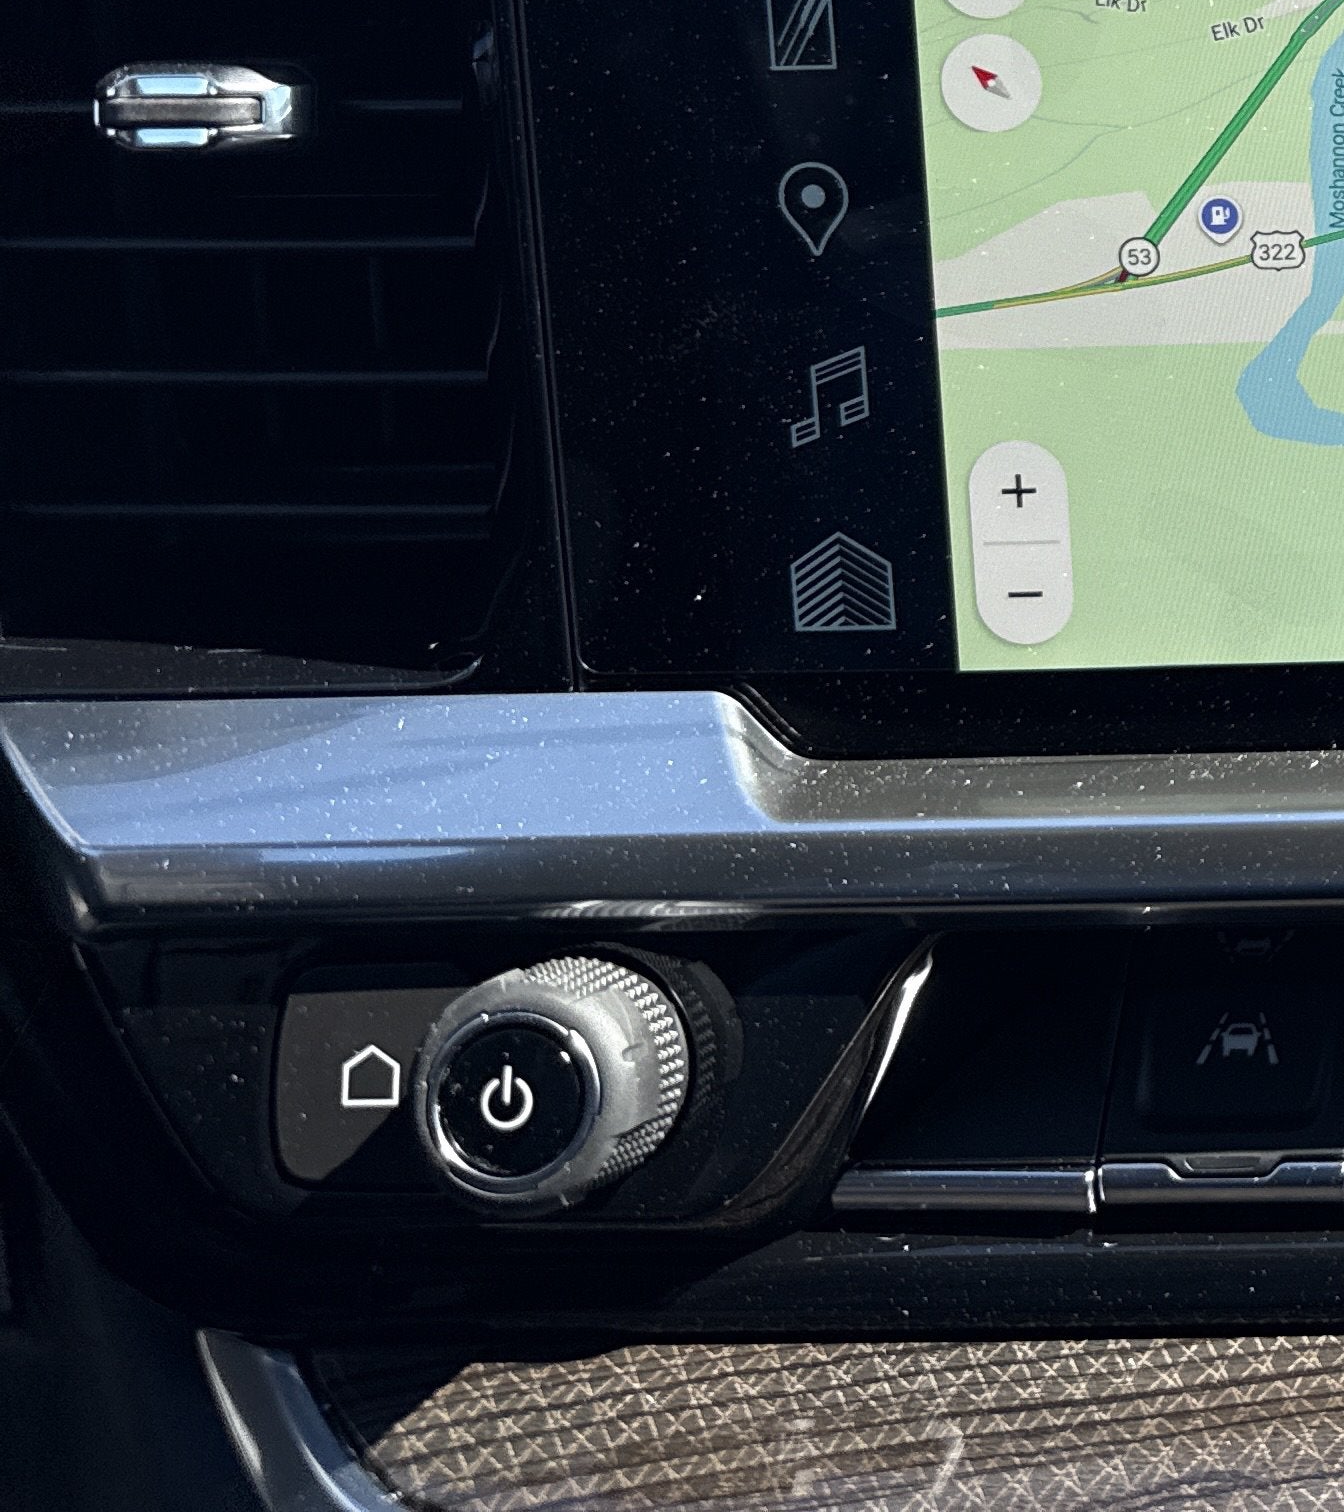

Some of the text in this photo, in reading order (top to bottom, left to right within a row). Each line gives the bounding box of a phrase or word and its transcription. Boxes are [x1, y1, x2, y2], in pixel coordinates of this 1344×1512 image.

[1210, 15, 1265, 42] Elk Dr
[1127, 249, 1151, 264] 53
[1258, 244, 1296, 261] 322
